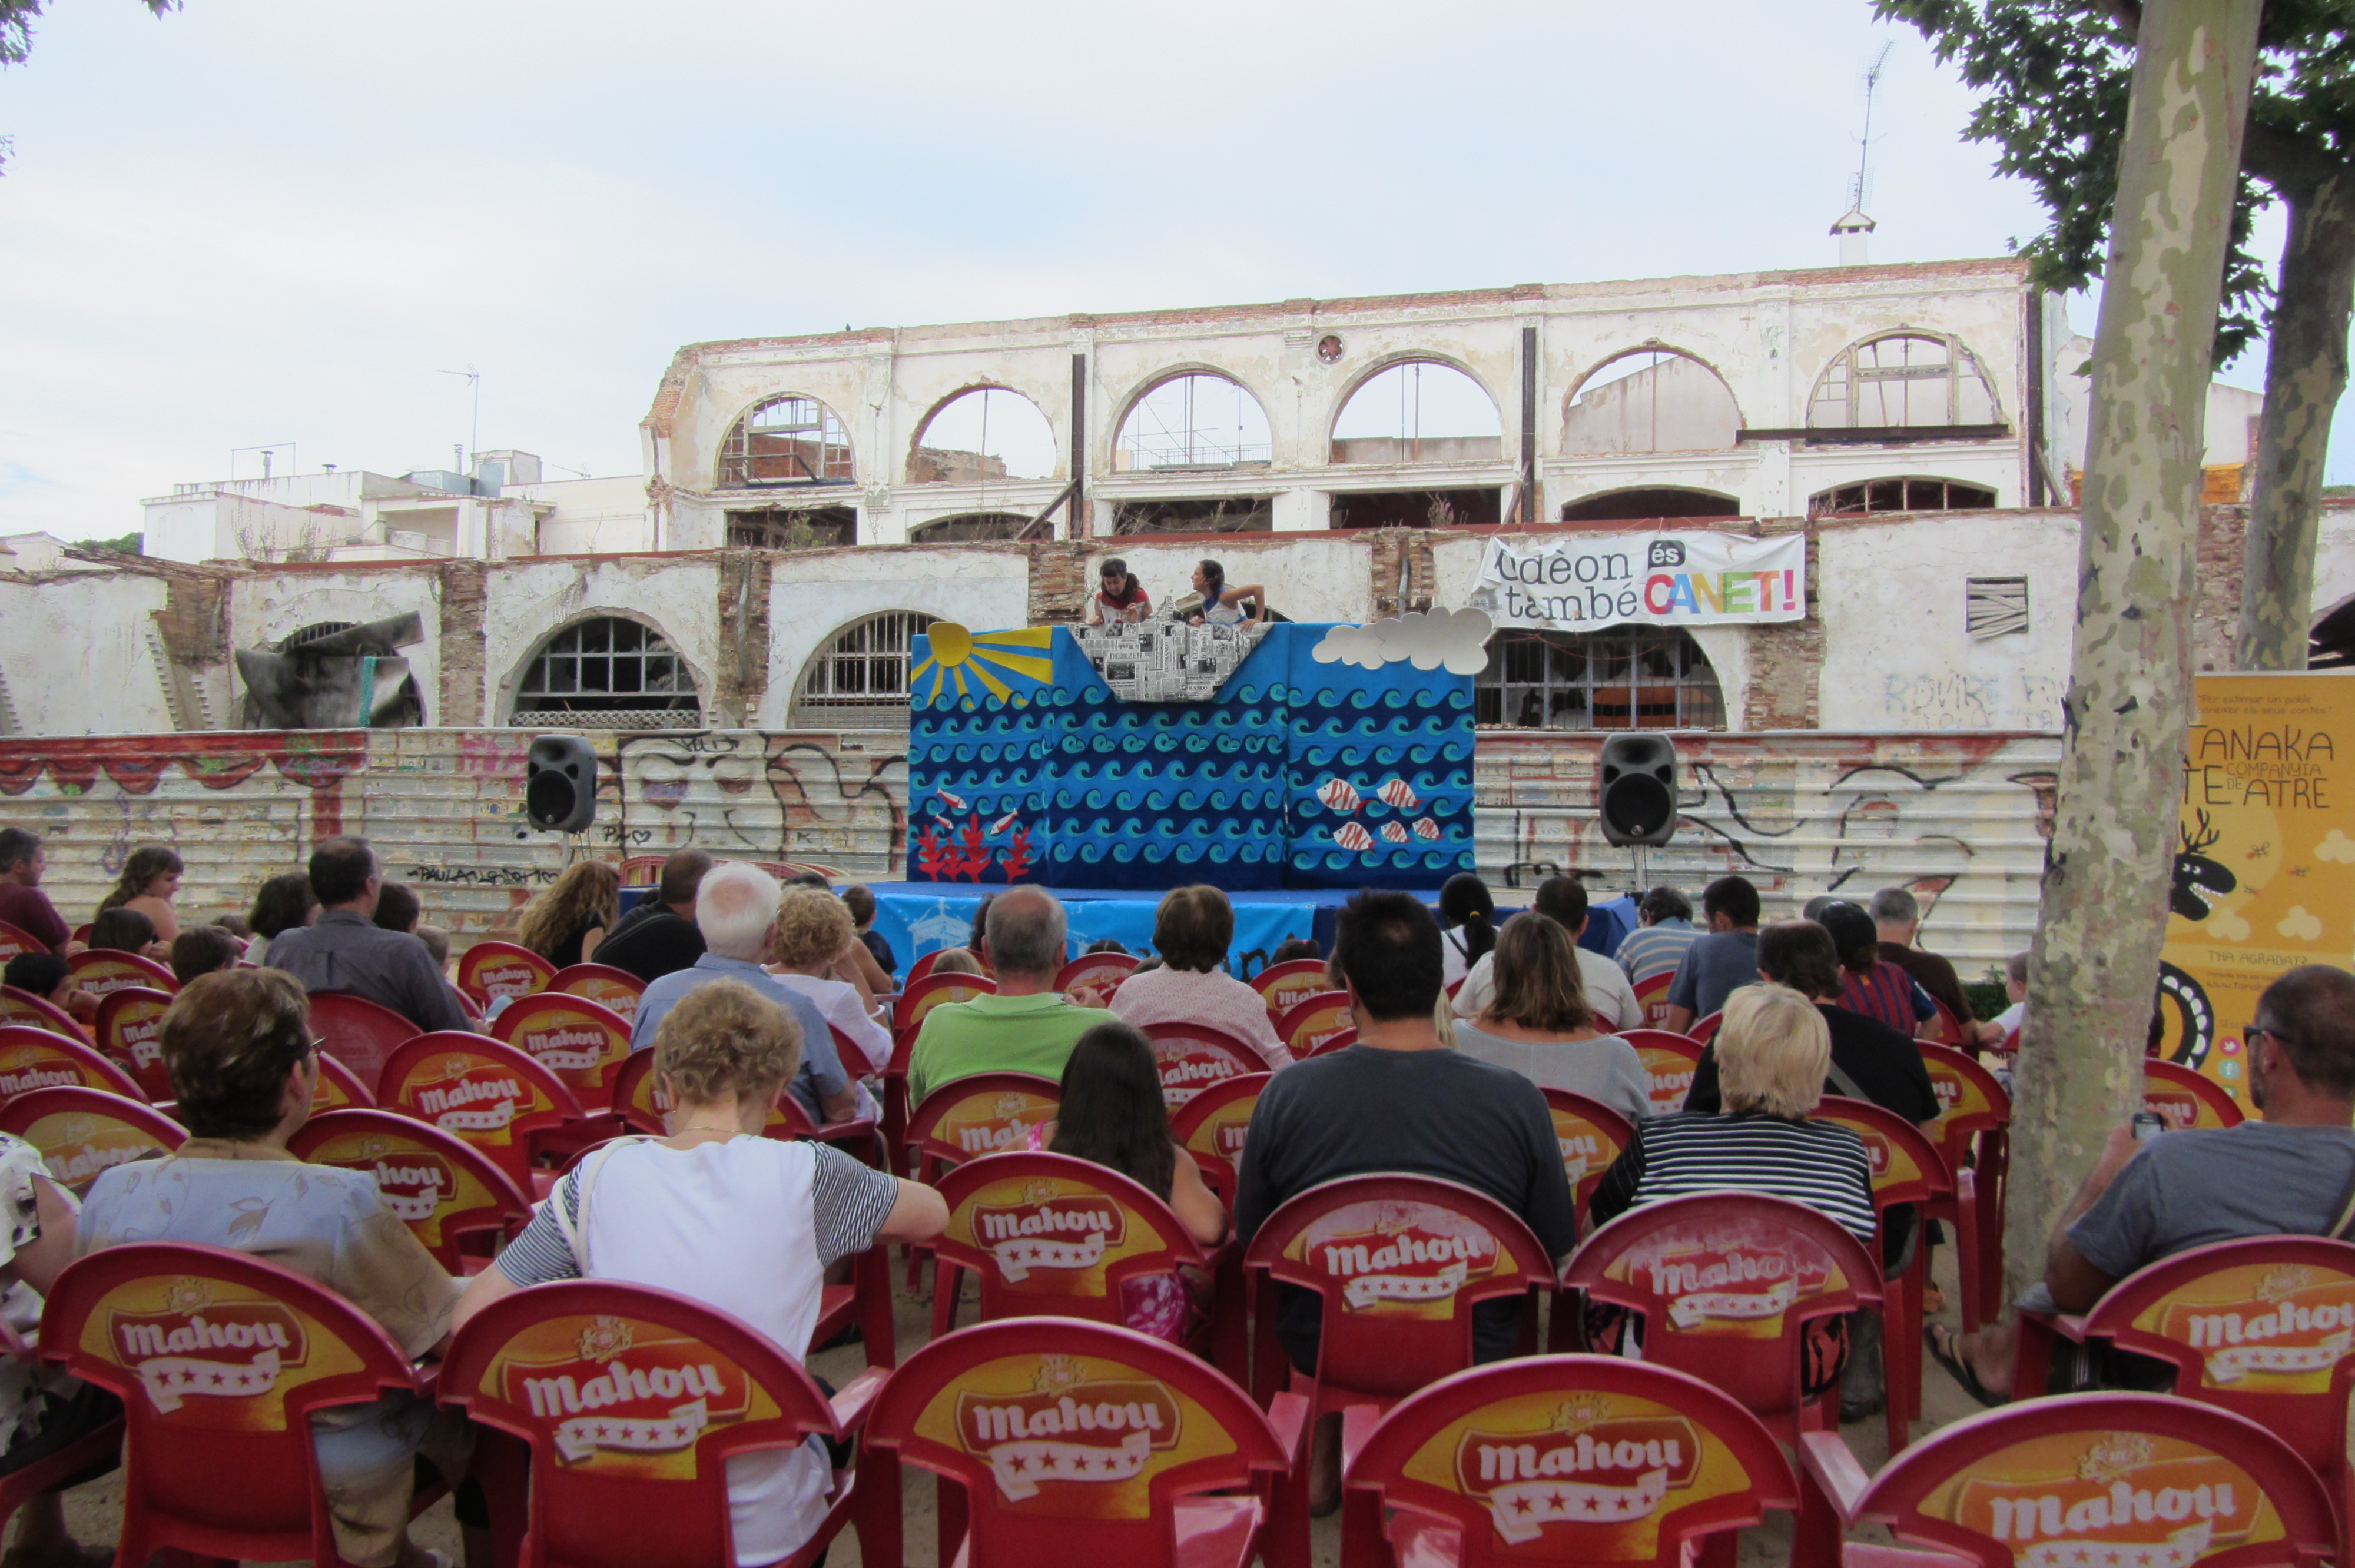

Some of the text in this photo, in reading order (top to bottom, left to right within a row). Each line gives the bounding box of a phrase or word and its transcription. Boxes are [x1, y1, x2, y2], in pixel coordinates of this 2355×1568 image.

[1495, 548, 1633, 584] Odèon
[1651, 543, 1680, 564] és
[1505, 581, 1637, 621] també
[1644, 569, 1796, 615] CANET!
[2227, 762, 2322, 777] COMPANYIA
[2227, 778, 2243, 790] DE
[528, 1025, 604, 1051] Mahou
[1160, 1059, 1233, 1086] ahou
[1646, 1071, 1695, 1091] hou
[419, 1078, 523, 1114] Mahou
[959, 1118, 1034, 1151] Mah
[377, 1161, 445, 1186] hou
[983, 1207, 1114, 1238] Mahou
[1325, 1235, 1480, 1276] Mahou
[121, 1316, 291, 1356] Mahou
[523, 1361, 727, 1417] Mahou
[973, 1397, 1164, 1440] Mahou
[1478, 1434, 1683, 1481] Mahou
[1990, 1481, 2236, 1539] Mahou
